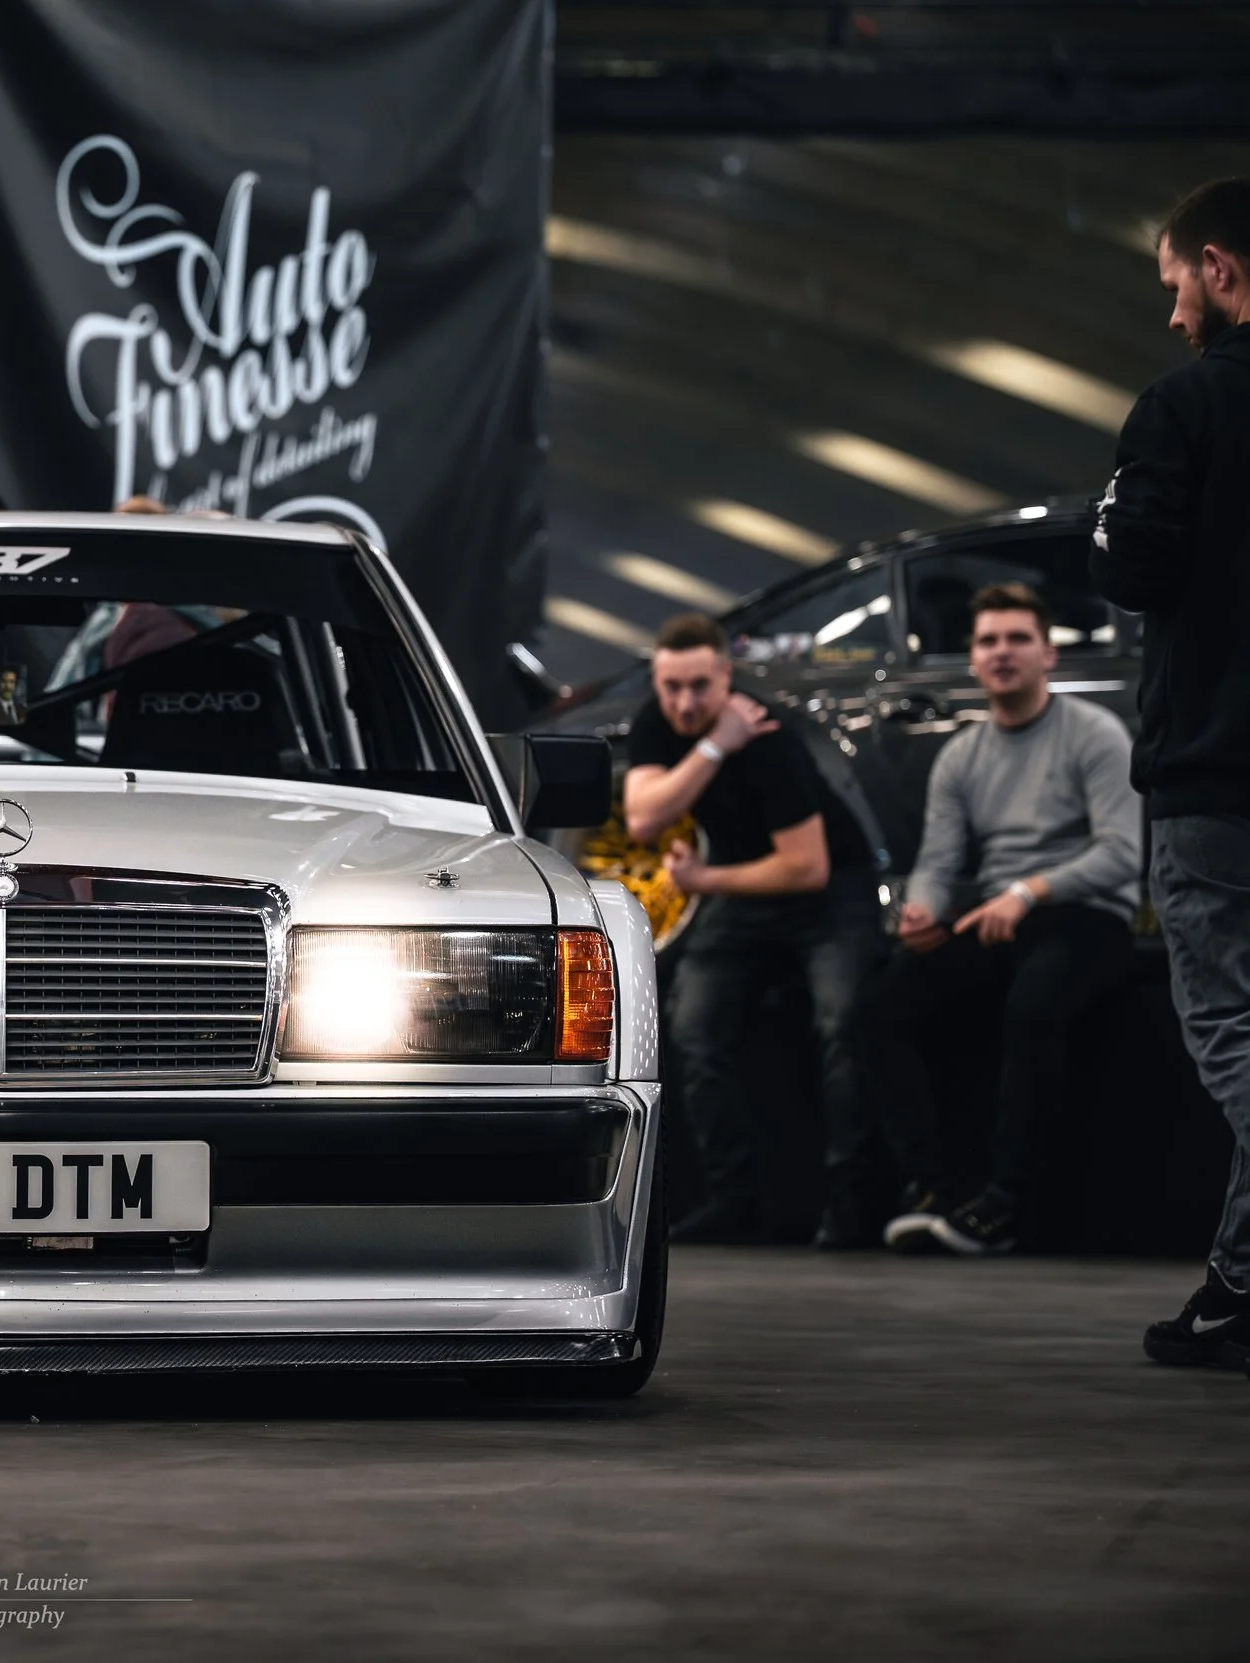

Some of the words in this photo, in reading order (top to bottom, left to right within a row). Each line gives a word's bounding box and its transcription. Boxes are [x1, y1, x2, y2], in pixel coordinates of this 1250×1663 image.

[56, 133, 376, 384] Auto
[66, 304, 370, 513] Finesse
[139, 691, 262, 715] RECARO
[12, 1153, 154, 1220] DTM
